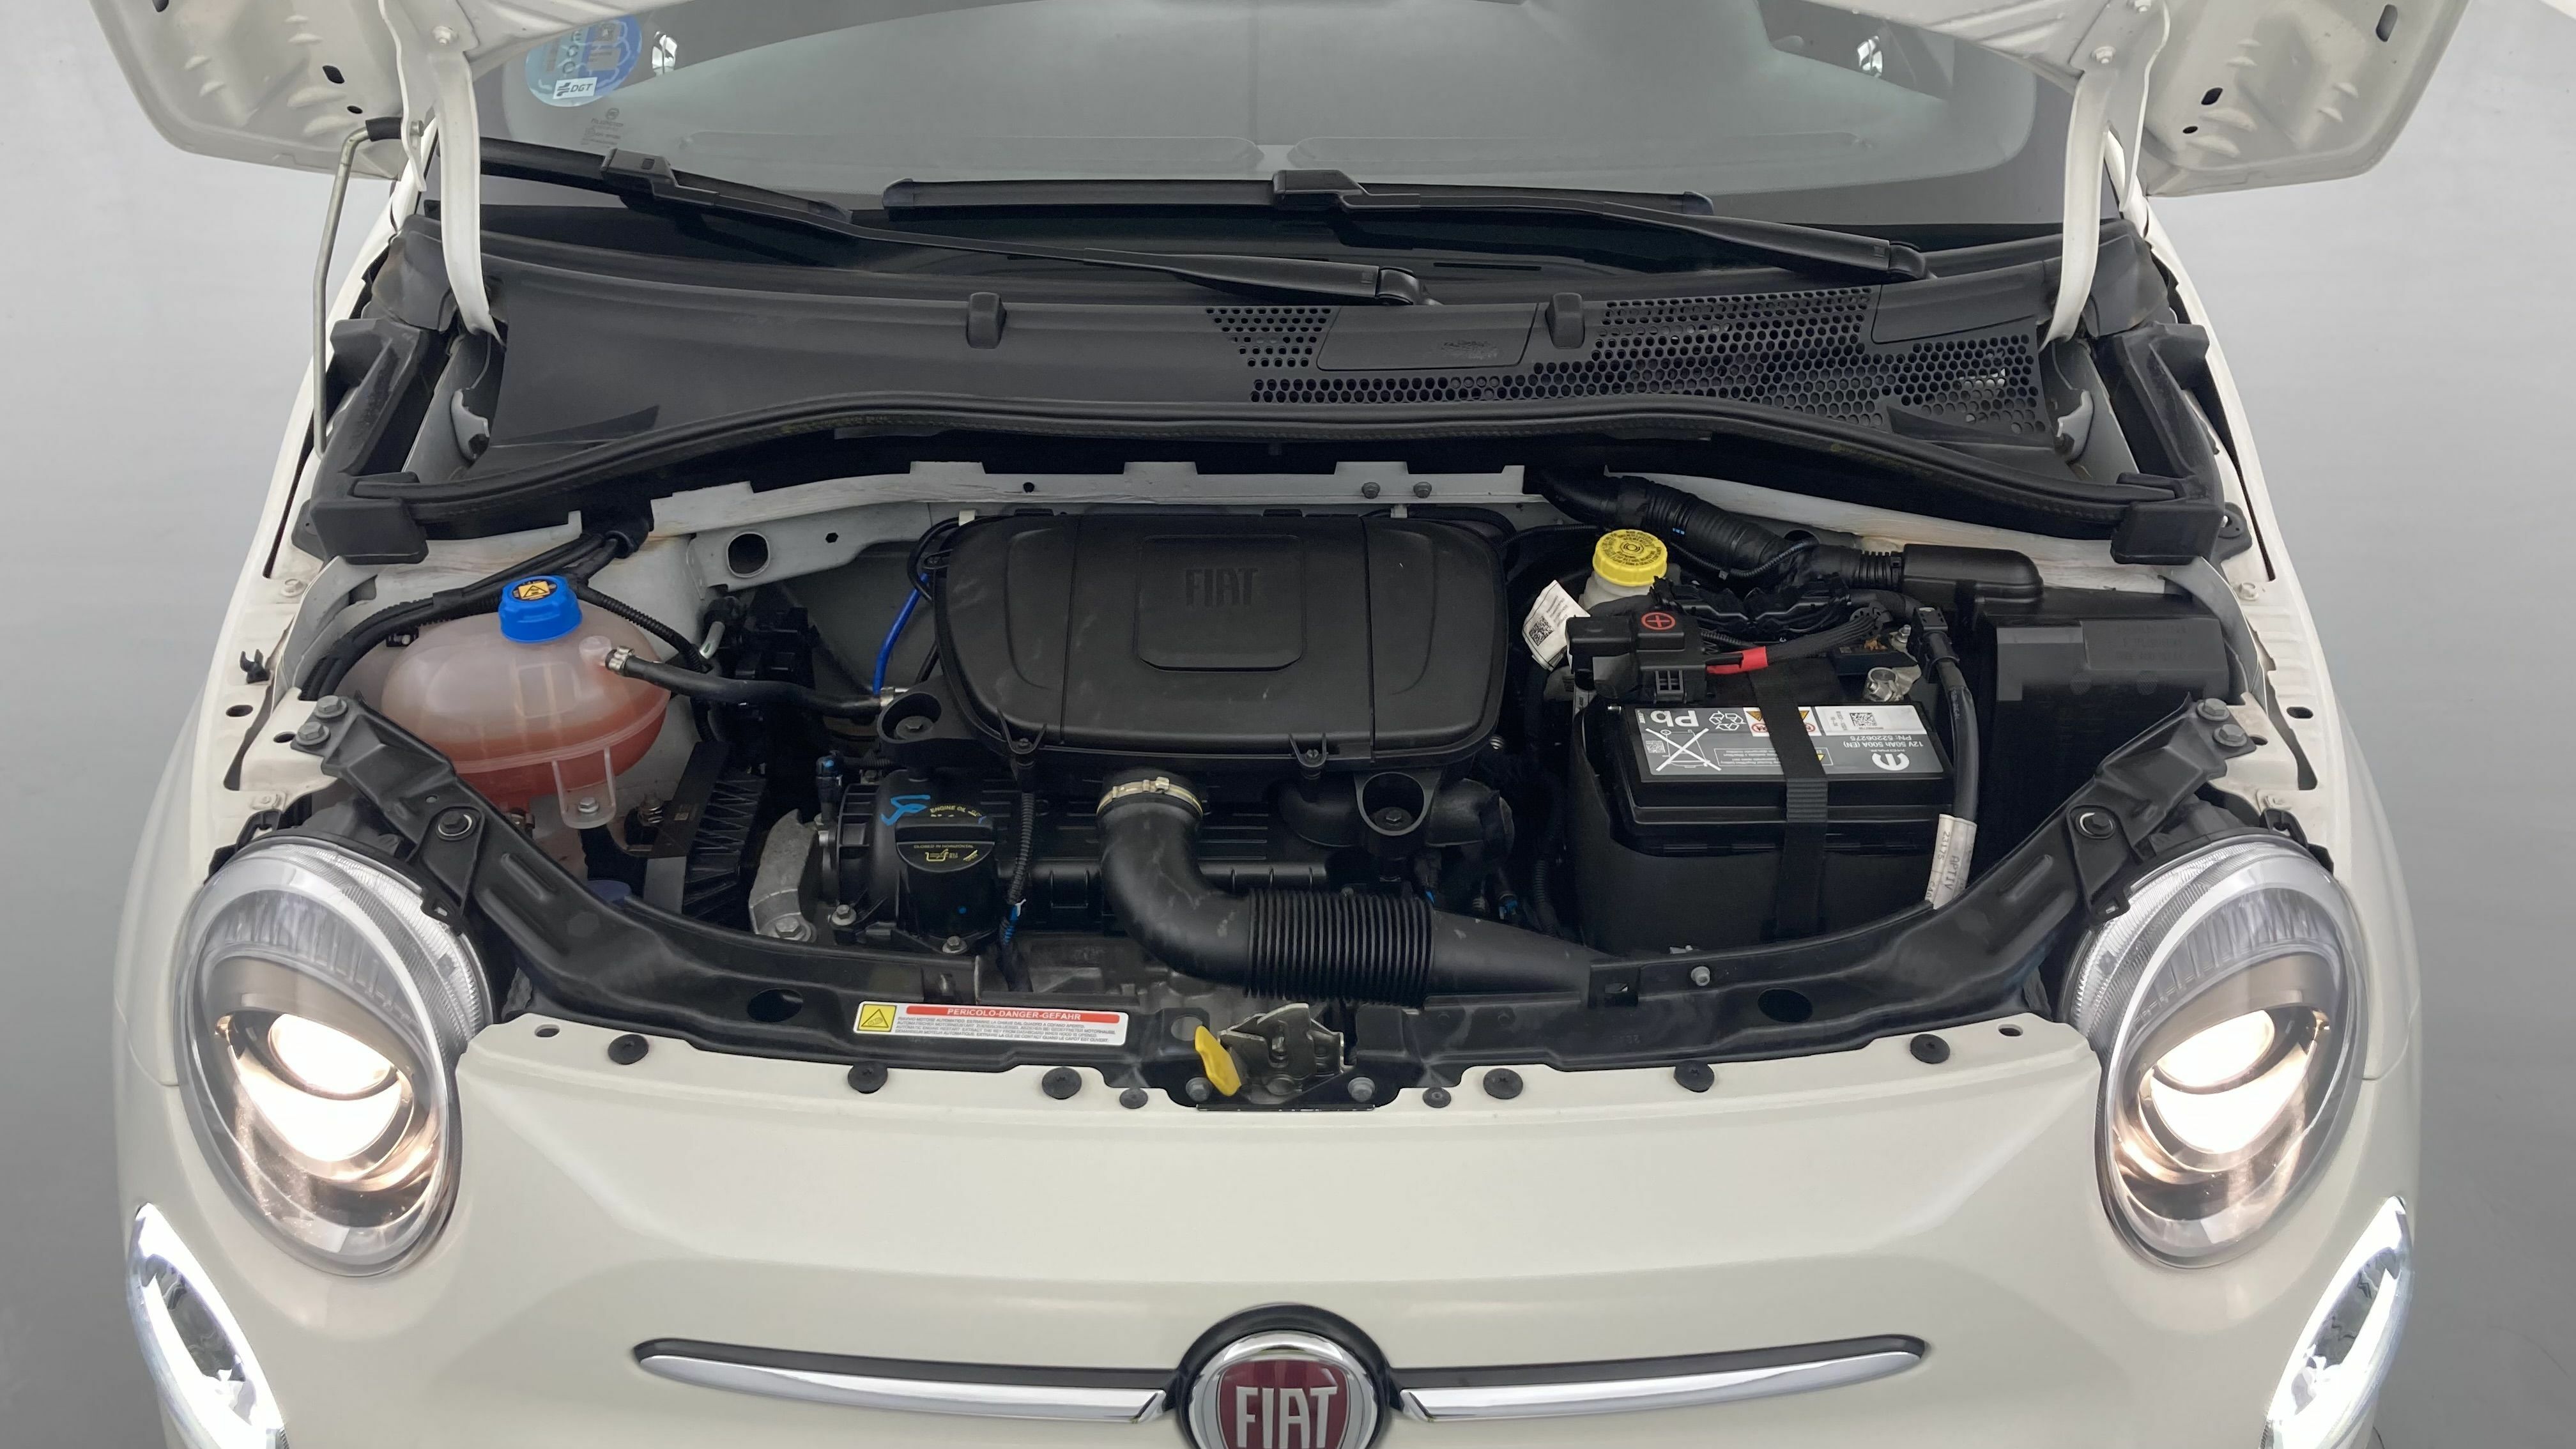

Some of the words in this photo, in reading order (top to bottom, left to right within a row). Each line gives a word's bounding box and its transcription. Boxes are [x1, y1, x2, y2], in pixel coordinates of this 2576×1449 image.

[571, 83, 594, 93] DGT
[1185, 567, 1259, 608] FIAT
[1650, 710, 1699, 727] Pb
[930, 805, 956, 813] ENGINE
[1938, 831, 1950, 860] 23175
[1944, 855, 1960, 890] APTIV
[947, 1008, 1081, 1020] PERICOLO-DANGER-GEFAHR
[1236, 1385, 1338, 1449] FIAT
